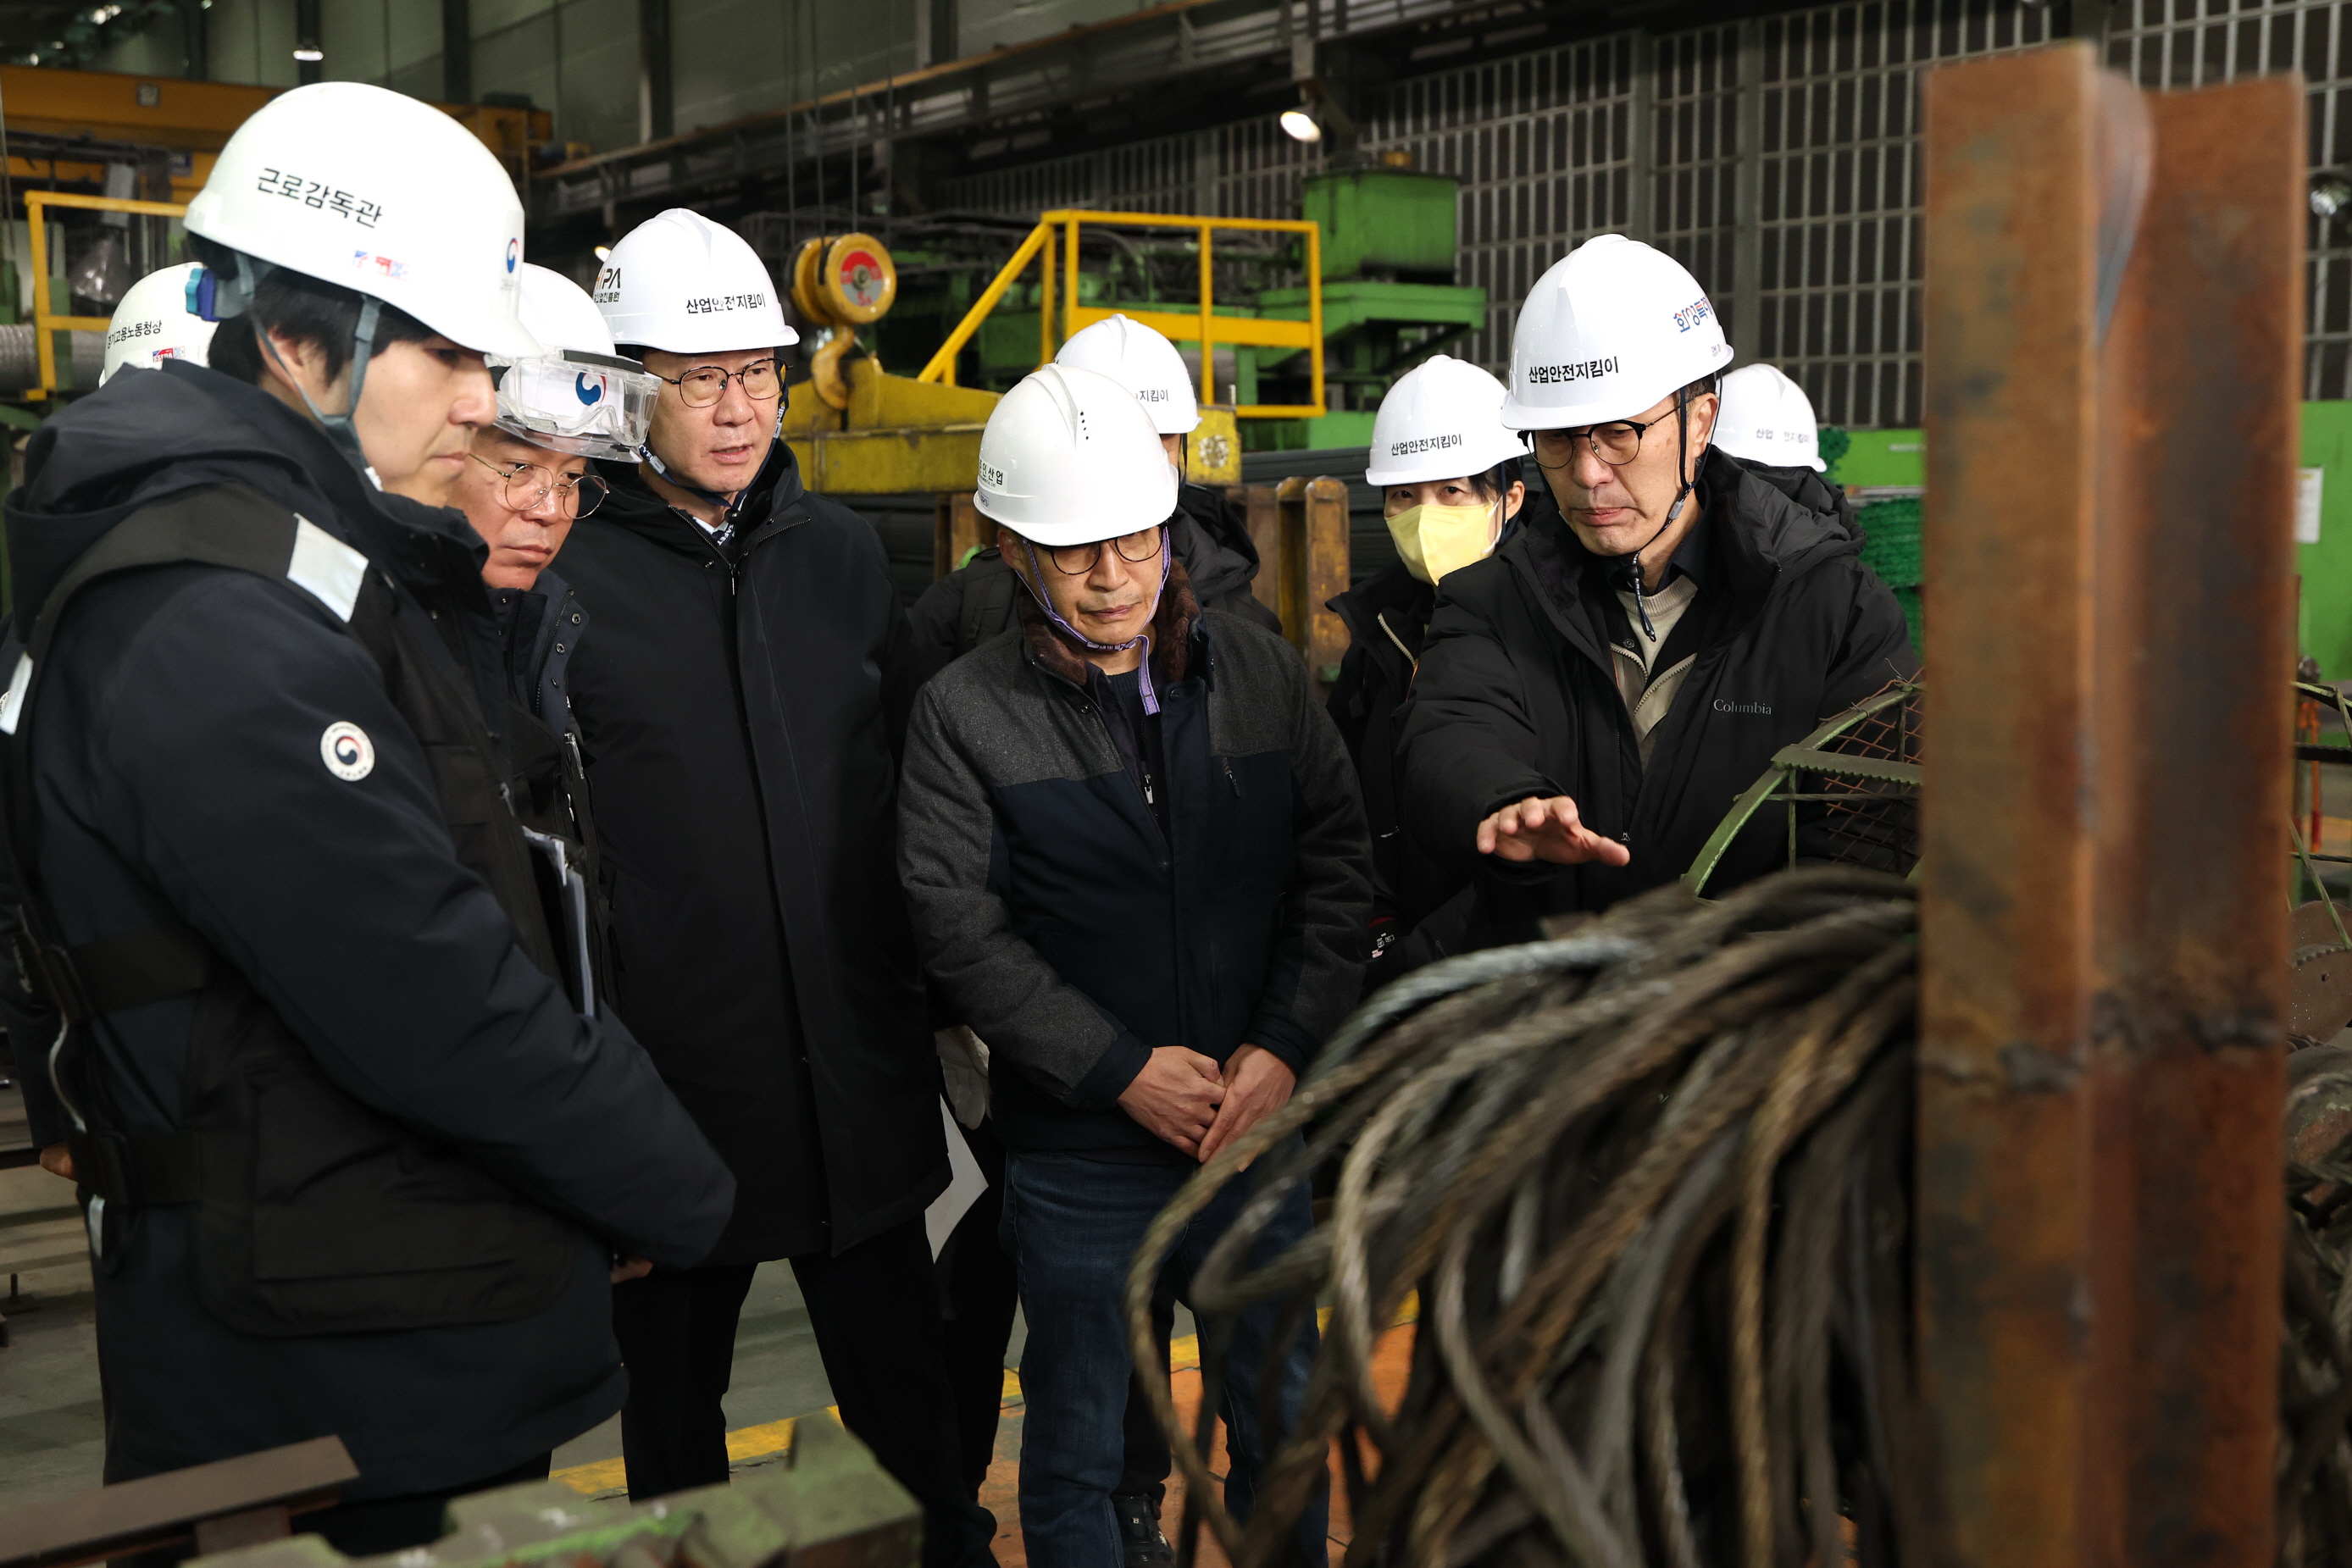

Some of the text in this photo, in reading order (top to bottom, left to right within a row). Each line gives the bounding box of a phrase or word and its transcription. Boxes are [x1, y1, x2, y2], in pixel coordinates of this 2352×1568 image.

[258, 168, 382, 229] 근로감독관
[686, 292, 766, 314] 산업안전지킴이
[1528, 356, 1619, 384] 산업안전지킴이
[1135, 389, 1168, 402] 지킴이
[1391, 433, 1462, 457] 산업안전지킴이
[1713, 698, 1772, 715] Columbia
